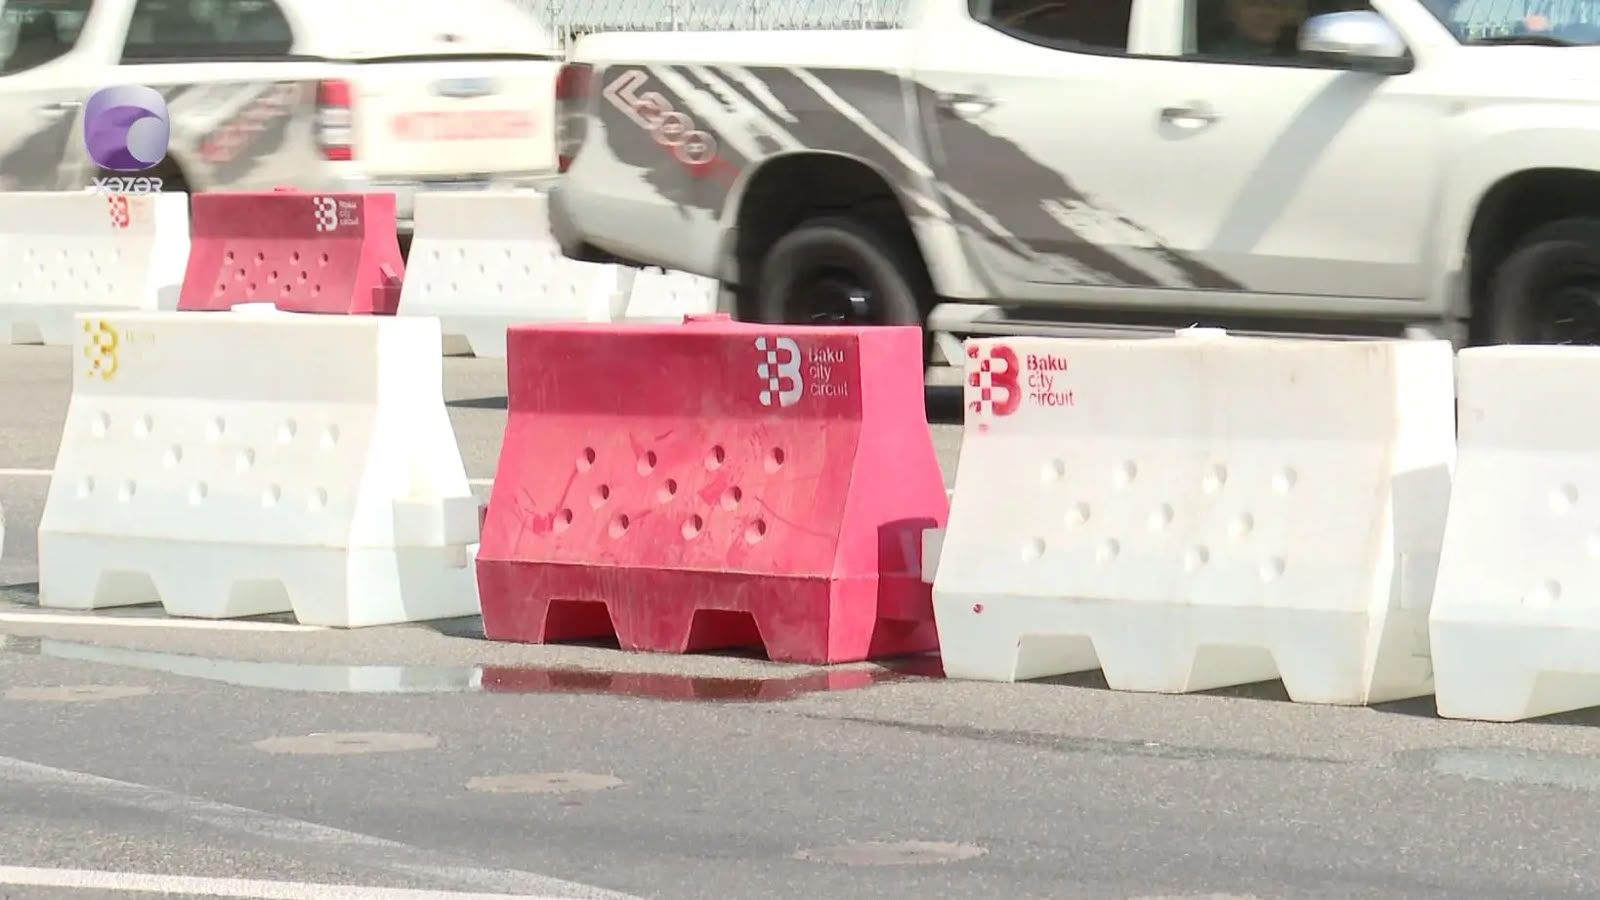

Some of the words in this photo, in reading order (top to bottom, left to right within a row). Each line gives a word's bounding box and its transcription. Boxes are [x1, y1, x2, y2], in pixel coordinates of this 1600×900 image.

[1026, 354, 1068, 371] Baku
[809, 362, 832, 383] city
[1028, 371, 1054, 392] city
[810, 381, 849, 397] circuit
